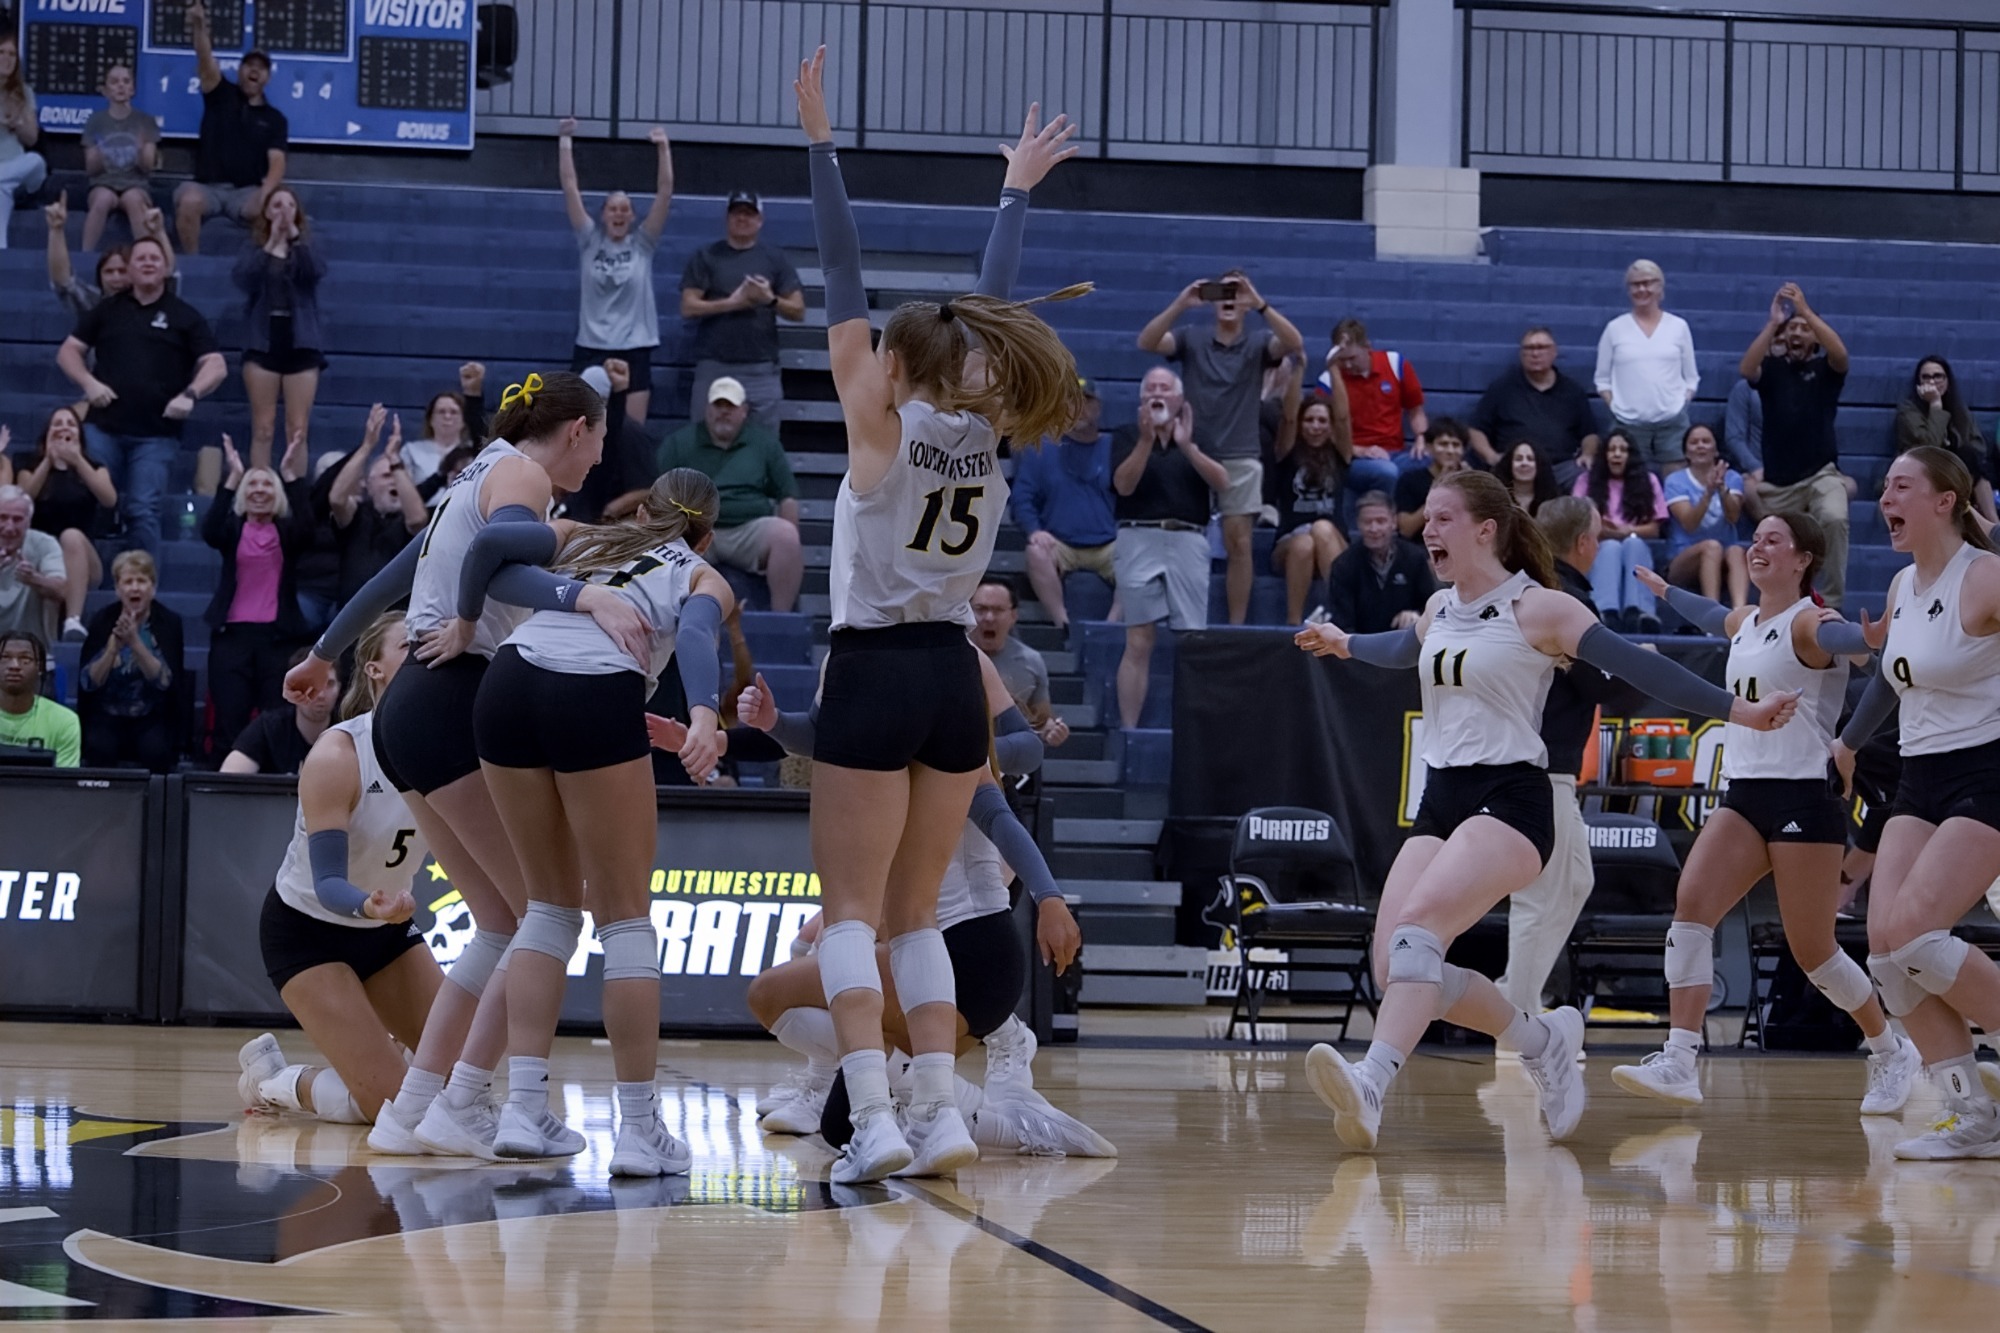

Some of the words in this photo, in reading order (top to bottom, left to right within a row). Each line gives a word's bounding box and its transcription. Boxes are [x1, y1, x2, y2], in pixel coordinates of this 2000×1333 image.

[364, 0, 466, 29] VISITOR
[160, 76, 169, 93] 1
[187, 78, 201, 94] 2
[291, 82, 304, 99] 3
[319, 83, 332, 100] 4
[40, 106, 93, 125] BONUS
[396, 121, 450, 140] BONUS
[905, 486, 984, 556] 15
[1432, 647, 1468, 687] 11
[1893, 656, 1914, 688] 9
[1249, 816, 1330, 841] PIRATES
[1584, 824, 1657, 848] IRATES
[385, 829, 416, 868] 5
[650, 869, 822, 896] OUTHWESTERN
